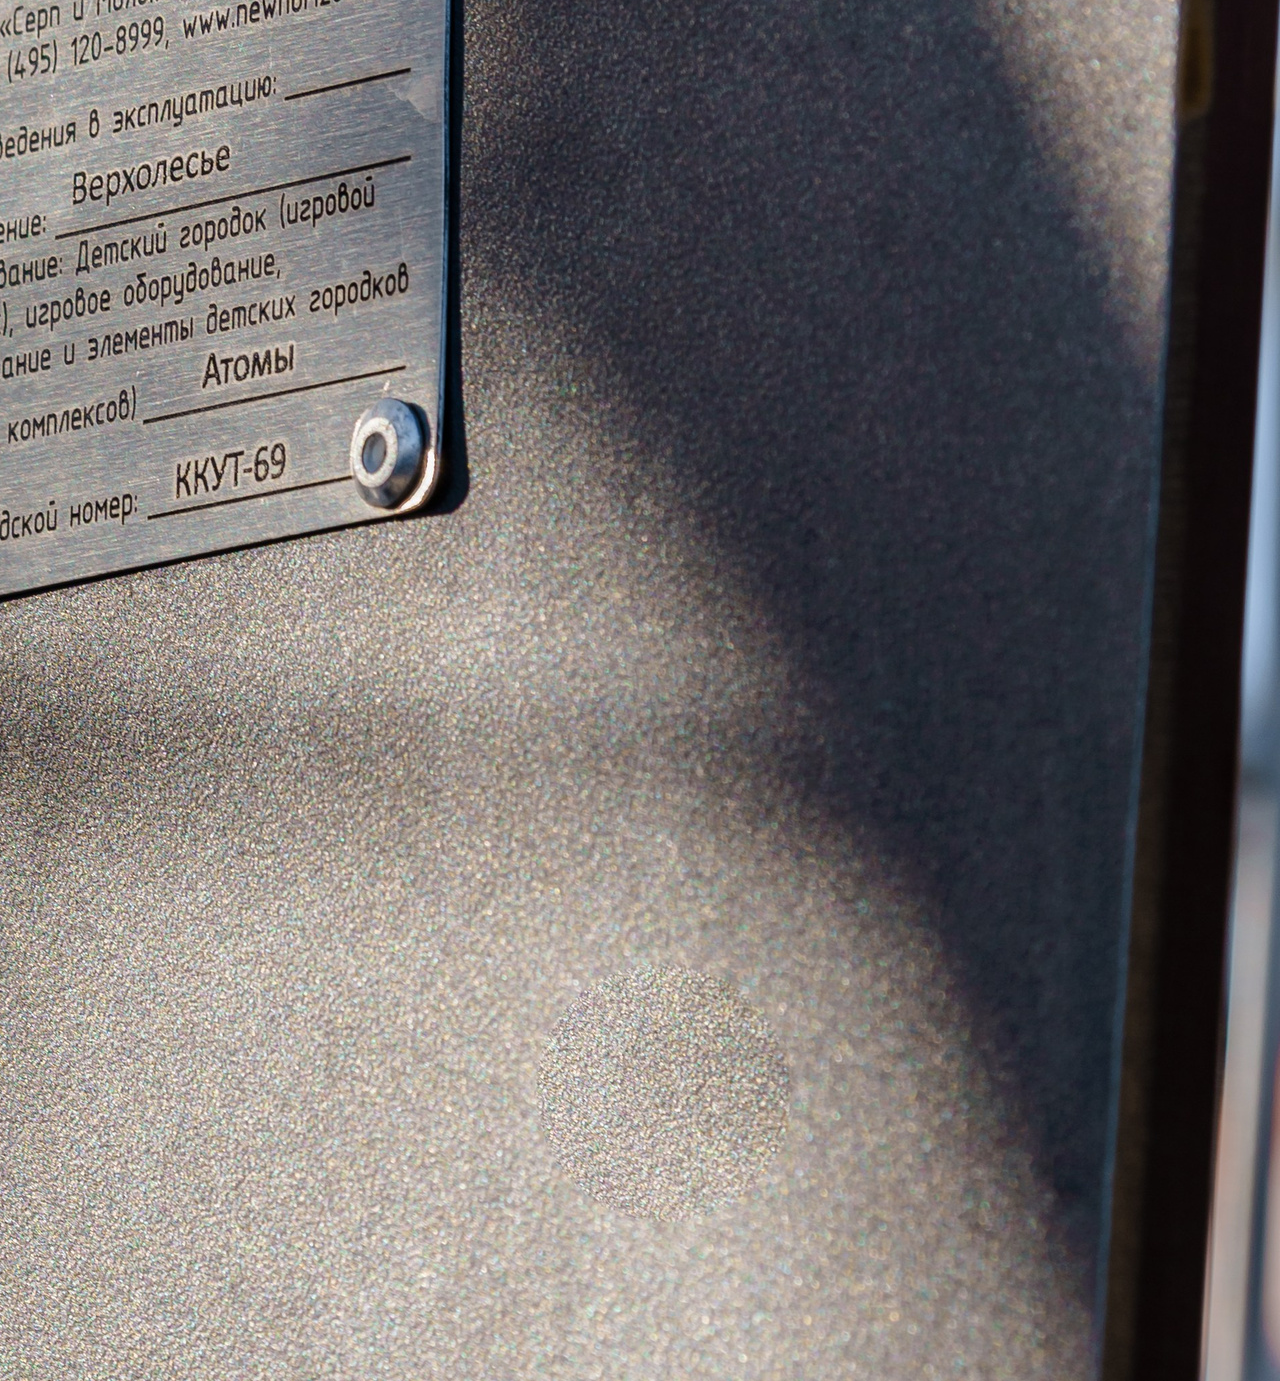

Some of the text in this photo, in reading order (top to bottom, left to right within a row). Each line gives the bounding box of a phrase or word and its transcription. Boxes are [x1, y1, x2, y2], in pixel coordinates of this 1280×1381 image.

[0, 6, 61, 44] «Серп
[73, 3, 85, 22] и
[7, 44, 59, 84] (495)
[71, 17, 170, 66] 120-8999,
[89, 110, 100, 138] в
[112, 76, 278, 134] эксплуатацию:
[72, 142, 232, 205] Верхолесье
[76, 222, 169, 277] Детский
[180, 207, 267, 254] городок
[279, 177, 376, 230] (игровой
[26, 287, 111, 332] игровое
[123, 251, 282, 309] оборудование,
[63, 343, 76, 366] и
[88, 316, 195, 360] элементы
[206, 295, 296, 335] детских
[309, 263, 410, 314] городков
[7, 386, 137, 441] комплексов)
[202, 343, 295, 389] Атомы
[70, 493, 139, 527] номер:
[176, 443, 287, 498] ККУТ-69
